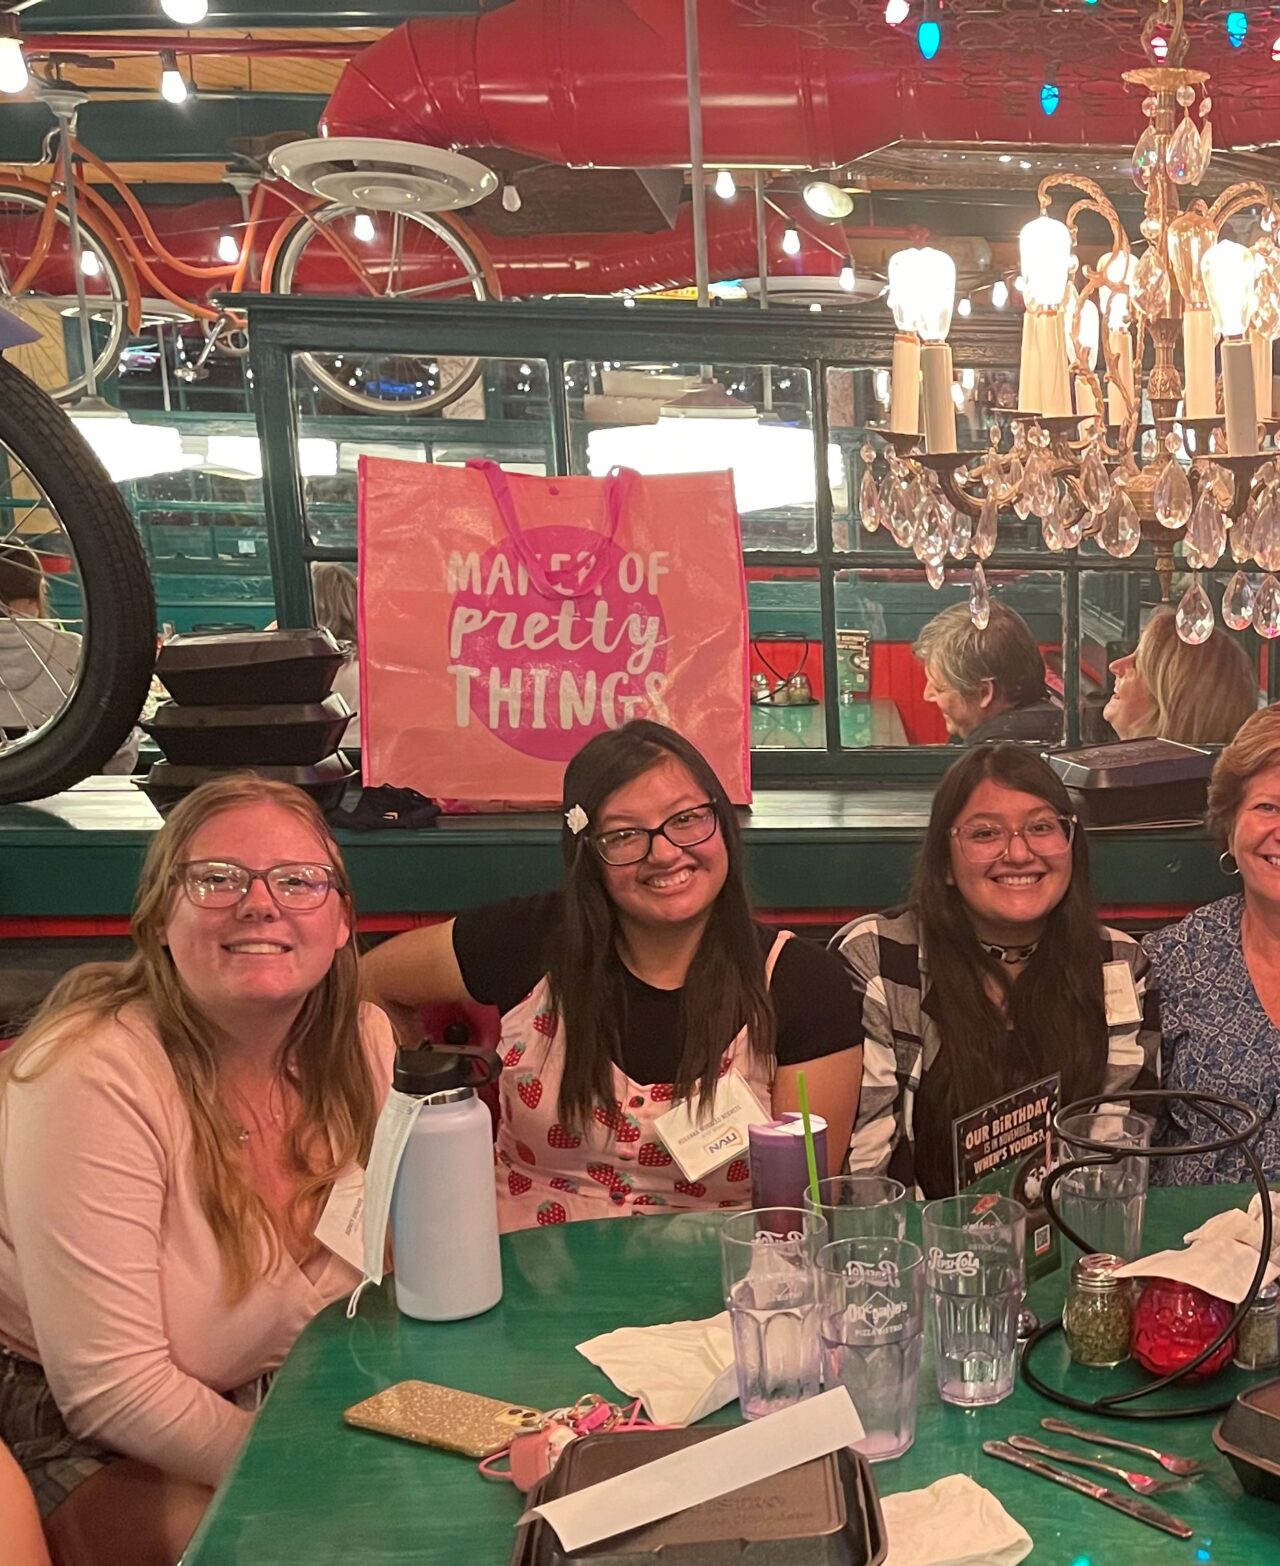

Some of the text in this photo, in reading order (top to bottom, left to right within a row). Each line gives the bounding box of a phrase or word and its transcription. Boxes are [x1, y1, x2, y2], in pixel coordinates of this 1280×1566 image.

[618, 551, 670, 596] OF
[450, 599, 676, 675] pretty
[446, 664, 670, 730] THINGS
[708, 1132, 737, 1153] NAU
[965, 1126, 990, 1149] OUR
[974, 1128, 1045, 1174] WHEN'S YOURS?
